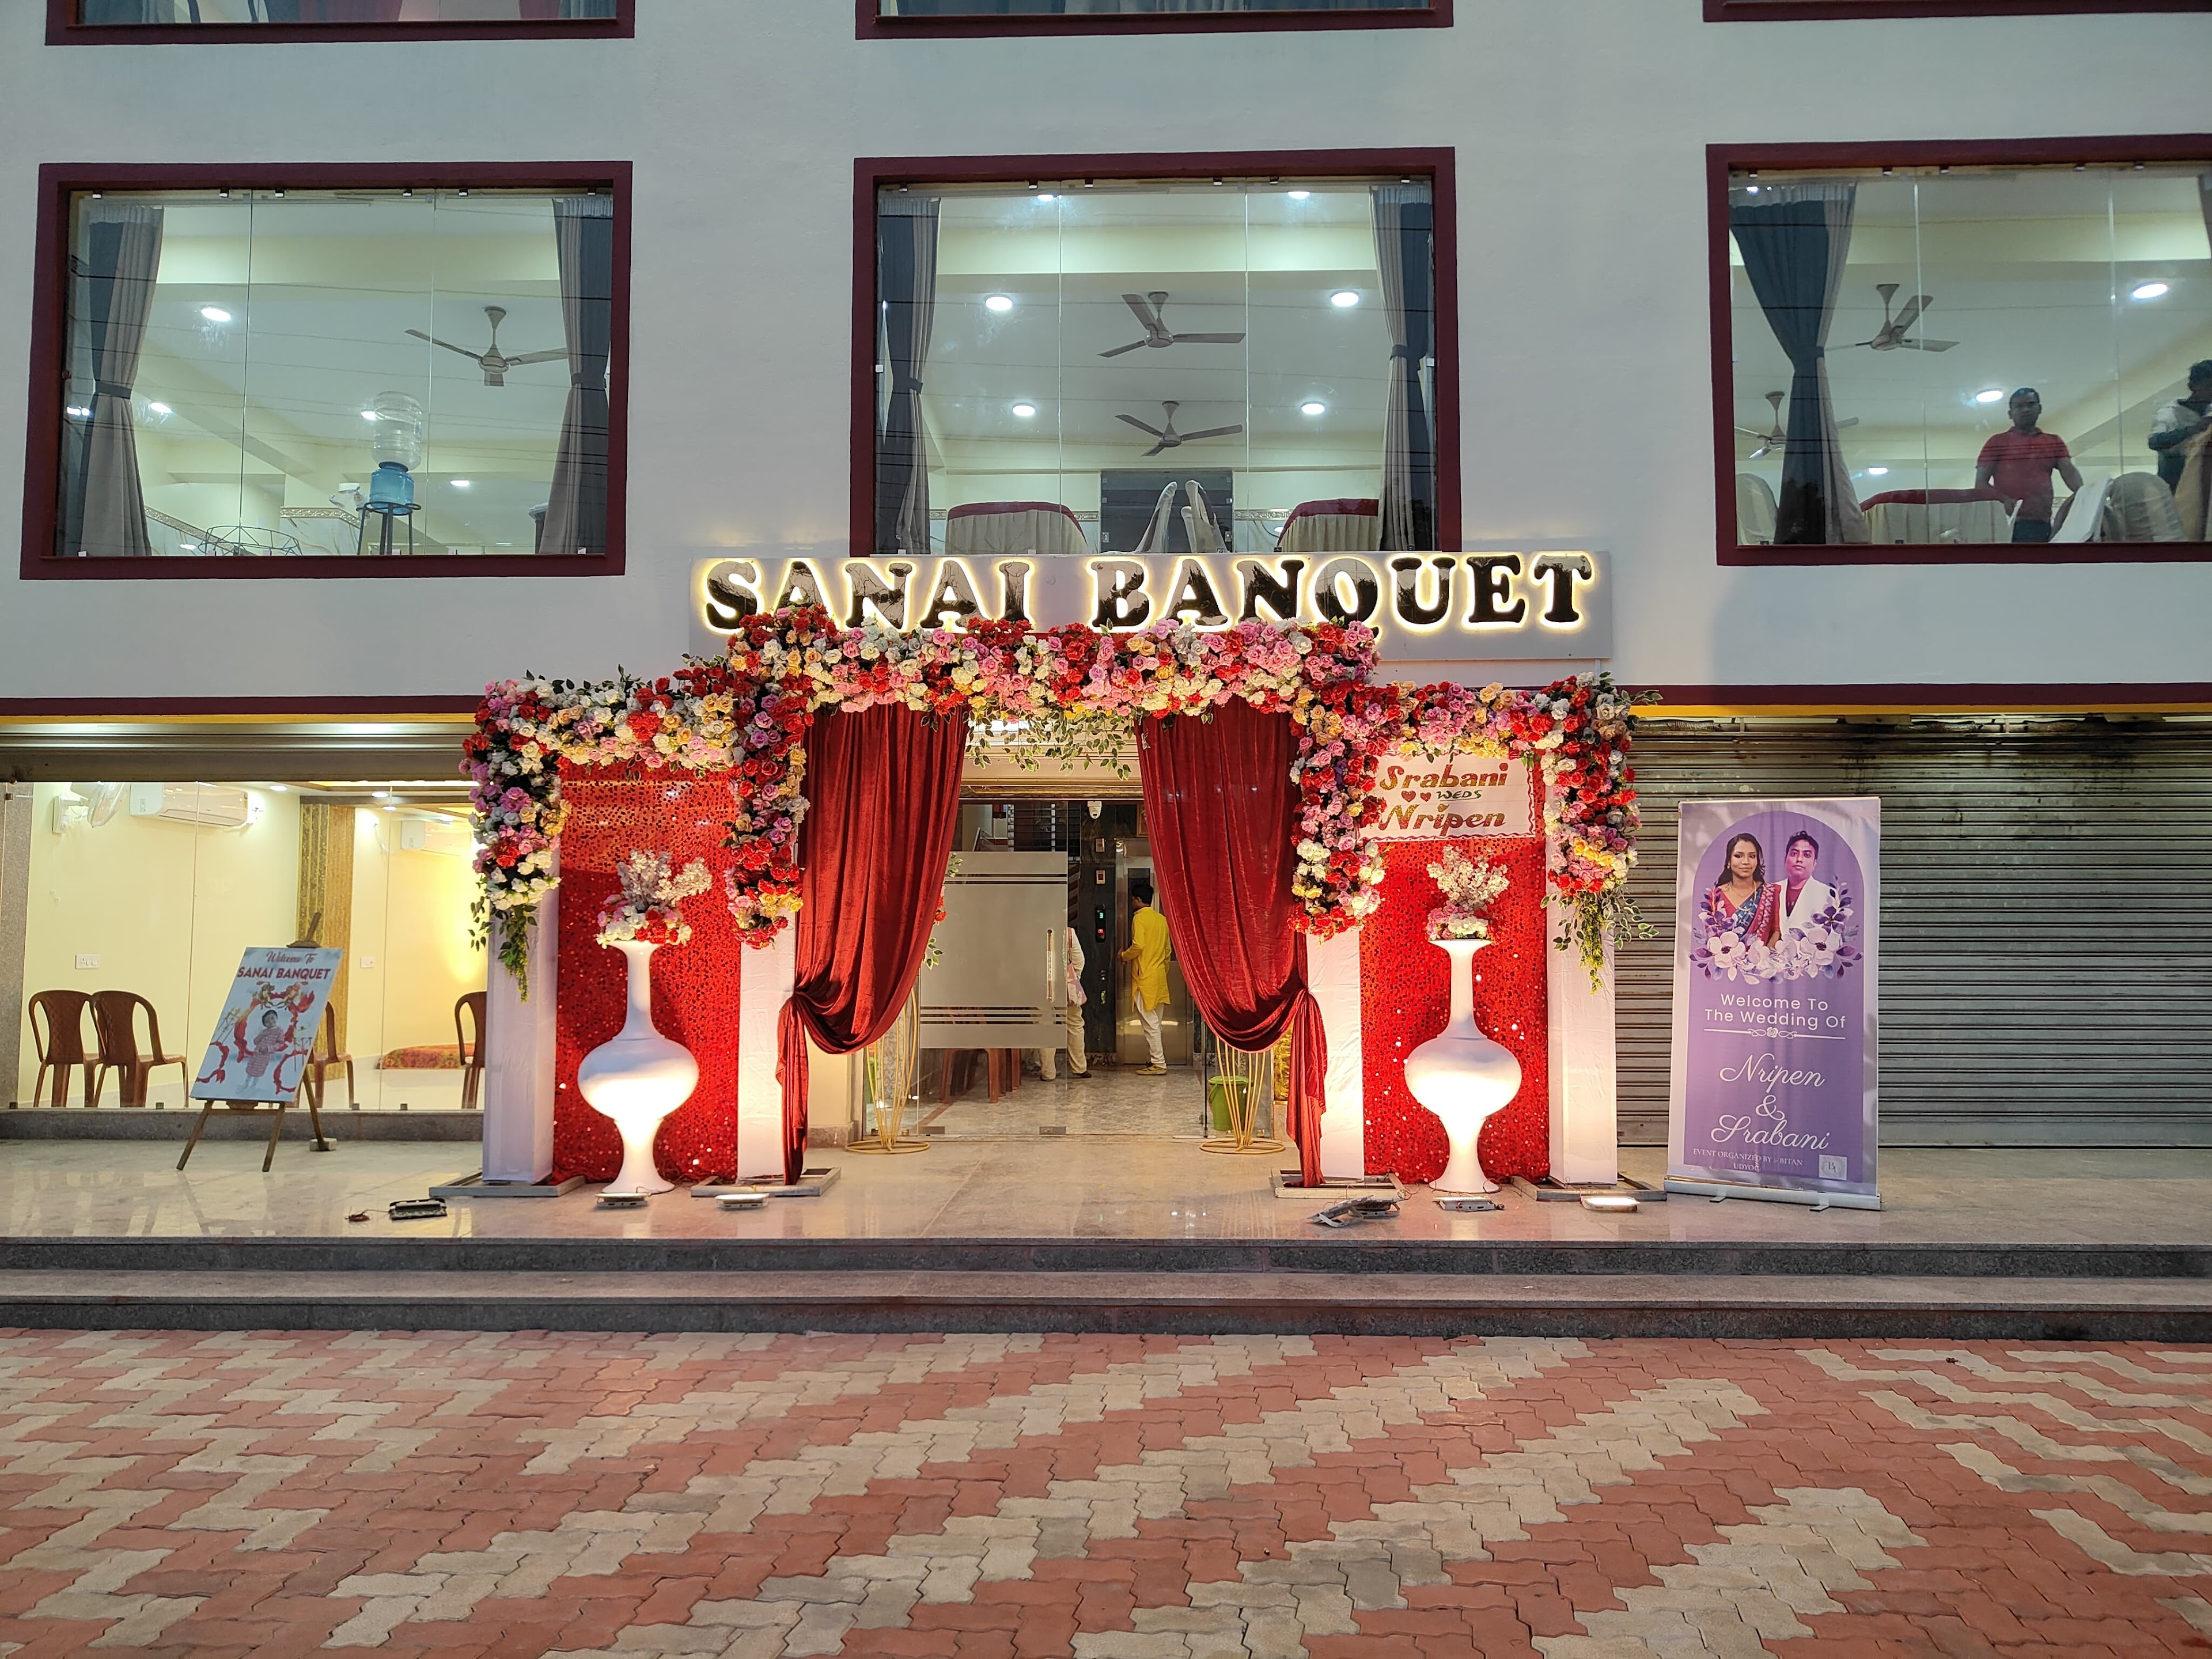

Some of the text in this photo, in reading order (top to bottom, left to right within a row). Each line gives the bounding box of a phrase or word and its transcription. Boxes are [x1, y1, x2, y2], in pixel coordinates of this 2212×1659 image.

[706, 556, 1592, 639] SANAI BANQUET
[1380, 763, 1508, 790] Srabani
[1436, 790, 1483, 800] WEDS
[1378, 804, 1506, 836] Nripen
[237, 967, 331, 980] SANAI BANQUET
[1720, 994, 1828, 1011] Welcome To
[1705, 1009, 1846, 1030] The Wedding Of
[1719, 1053, 1825, 1093] Nripen
[1755, 1094, 1785, 1120] &
[1710, 1115, 1830, 1150] Srabani
[1693, 1148, 1717, 1157] EVENT
[1717, 1151, 1762, 1162] ORGANIZED
[1763, 1154, 1772, 1162] BY
[1779, 1158, 1803, 1166] BITAN
